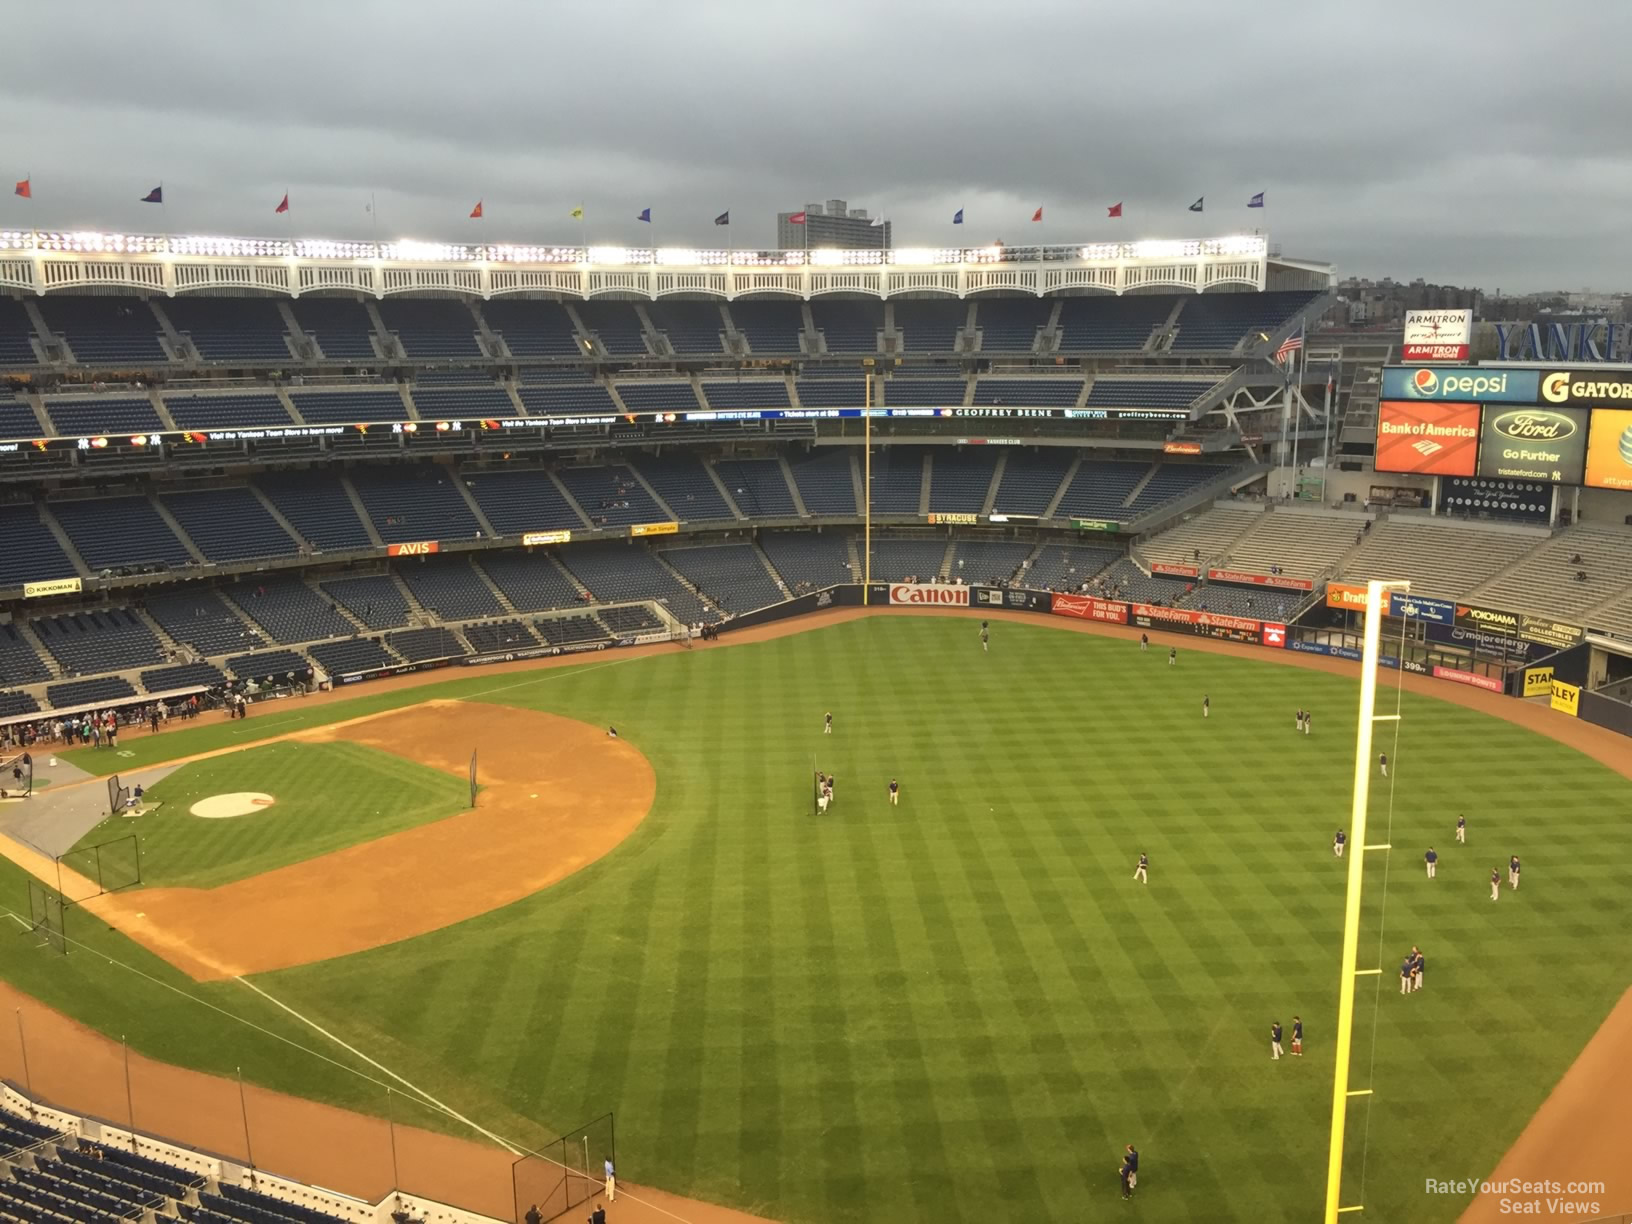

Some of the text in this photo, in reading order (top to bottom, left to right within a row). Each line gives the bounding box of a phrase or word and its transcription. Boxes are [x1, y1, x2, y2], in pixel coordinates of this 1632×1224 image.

[1408, 315, 1465, 324] ARMITRON
[1494, 322, 1632, 362] YANKE
[1408, 346, 1460, 354] ARMITRON
[1443, 373, 1507, 396] pepsi
[1017, 409, 1052, 417] BEENE
[1382, 421, 1476, 437] Bank of America
[1508, 414, 1560, 438] Ford
[1503, 449, 1560, 462] Go Further
[1498, 468, 1548, 478] tristateford.com
[936, 514, 977, 522] SYRACUSE
[398, 543, 430, 555] AVIS
[36, 584, 73, 593] KIKKOMAN
[891, 586, 968, 604] Canon
[1093, 601, 1127, 614] THIS BUD'S
[1093, 610, 1105, 618] FOR
[1470, 608, 1518, 626] YOKOHAMA
[1529, 626, 1573, 641] COLLECTIBLES
[1338, 650, 1358, 658] Experian
[343, 675, 362, 683] GEICO
